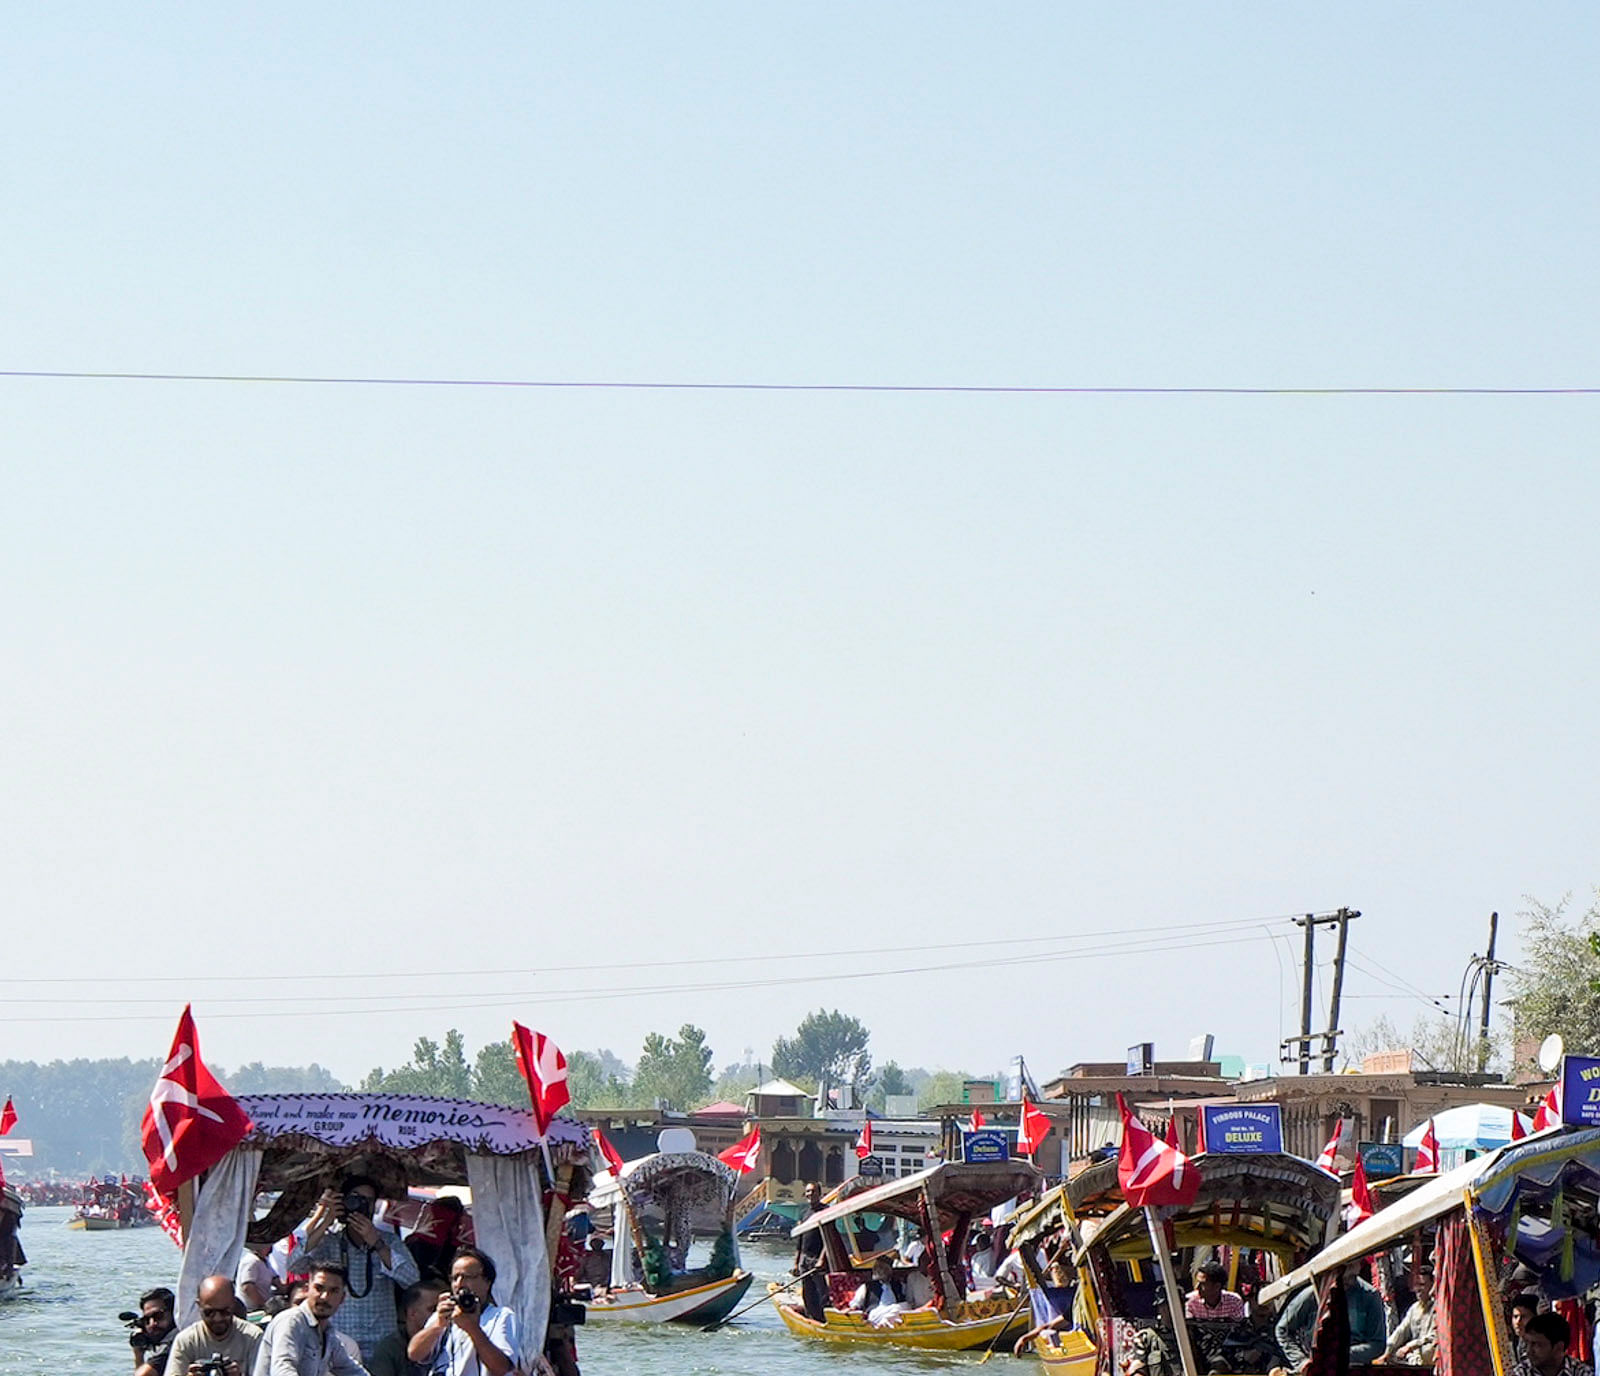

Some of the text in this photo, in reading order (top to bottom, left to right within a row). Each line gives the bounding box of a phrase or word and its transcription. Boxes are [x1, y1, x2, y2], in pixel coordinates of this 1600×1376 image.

[283, 1104, 304, 1119] and
[306, 1104, 335, 1119] make
[338, 1111, 358, 1120] new
[360, 1103, 506, 1128] Memories
[1244, 1111, 1271, 1124] PALACE
[314, 1121, 417, 1136] GROUP RIDE
[1225, 1132, 1263, 1143] DELUXE
